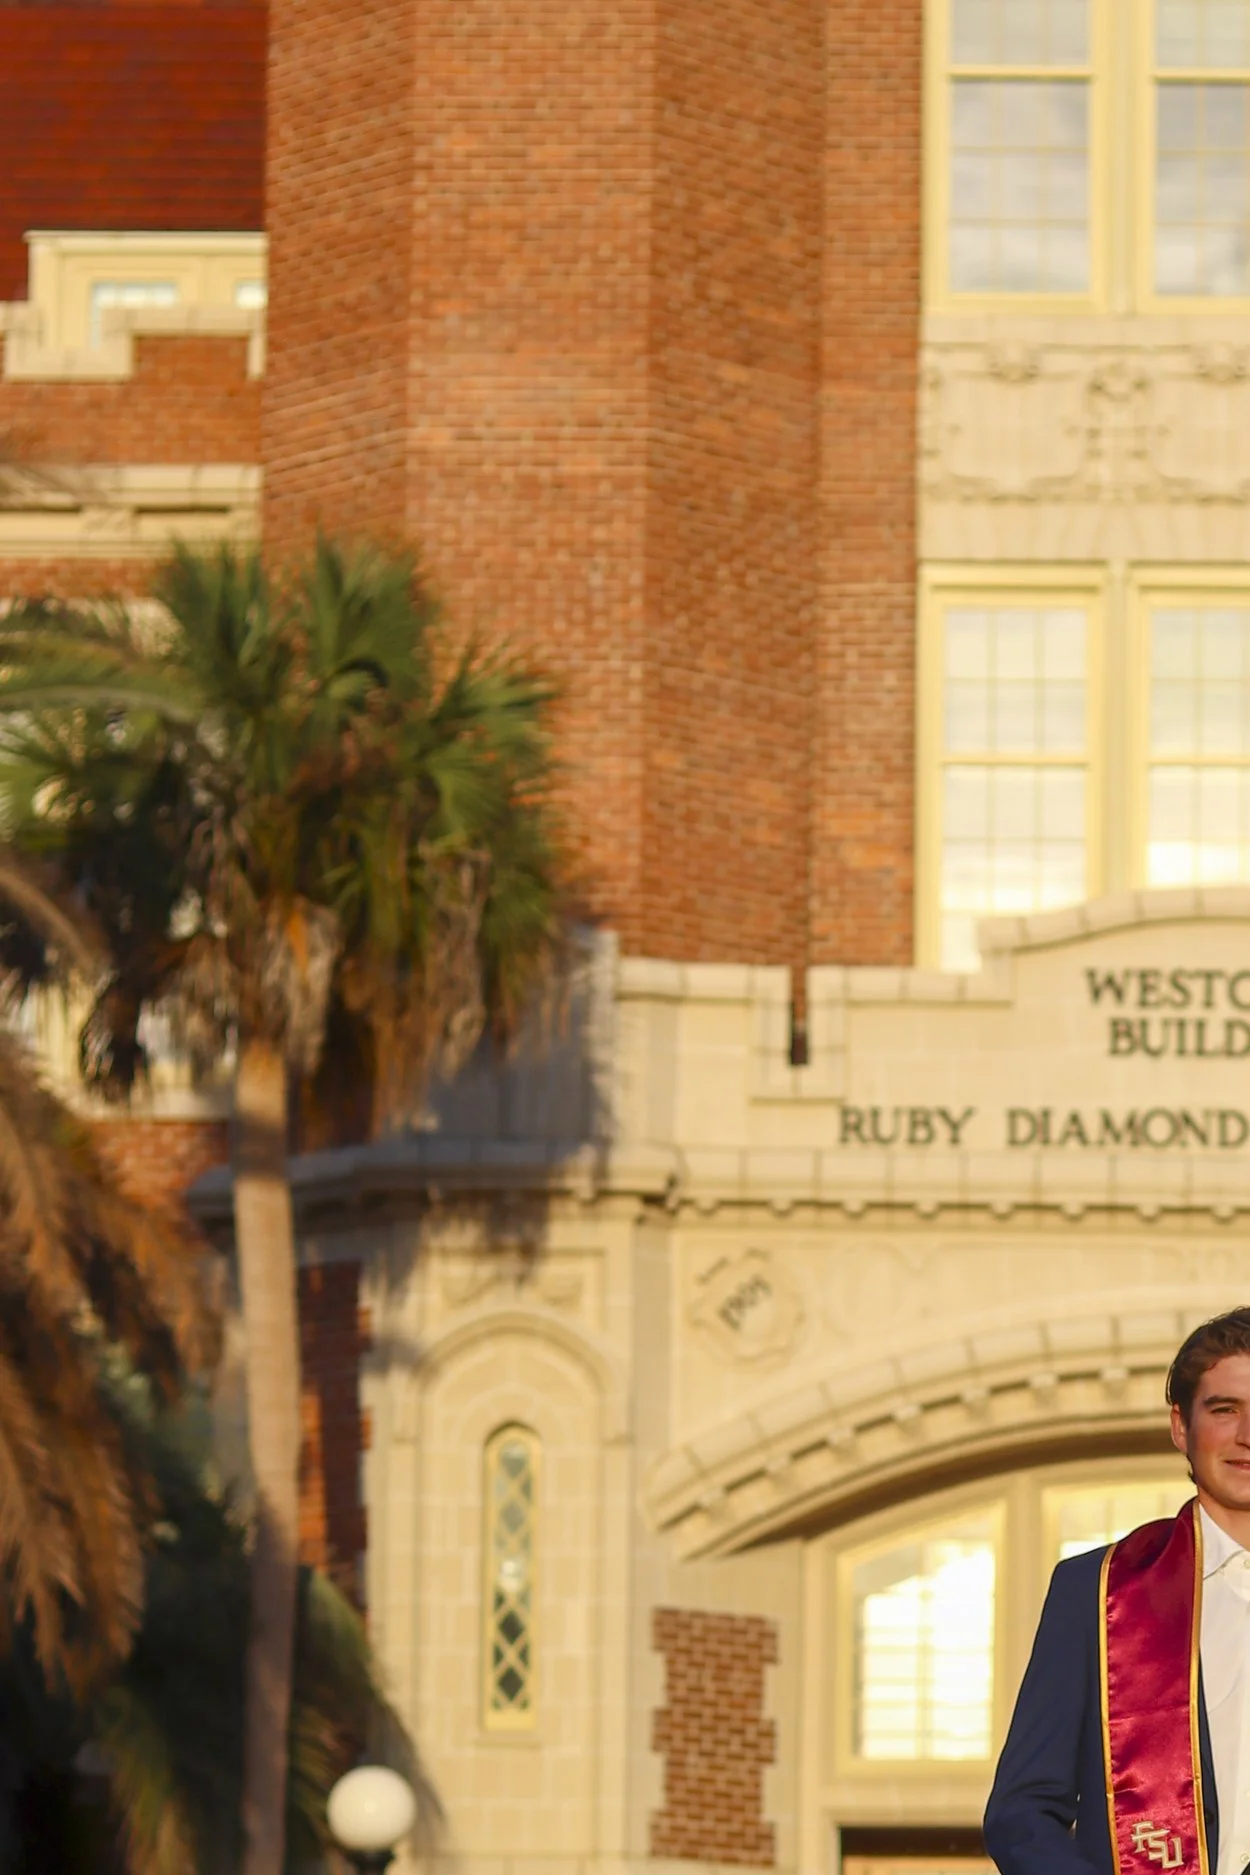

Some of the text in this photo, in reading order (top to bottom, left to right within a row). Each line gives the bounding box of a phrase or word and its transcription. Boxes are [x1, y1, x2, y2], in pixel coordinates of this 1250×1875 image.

[837, 1105, 976, 1148] RUBY
[1006, 1107, 1250, 1151] DIAMOND
[1130, 1820, 1185, 1869] FSU
